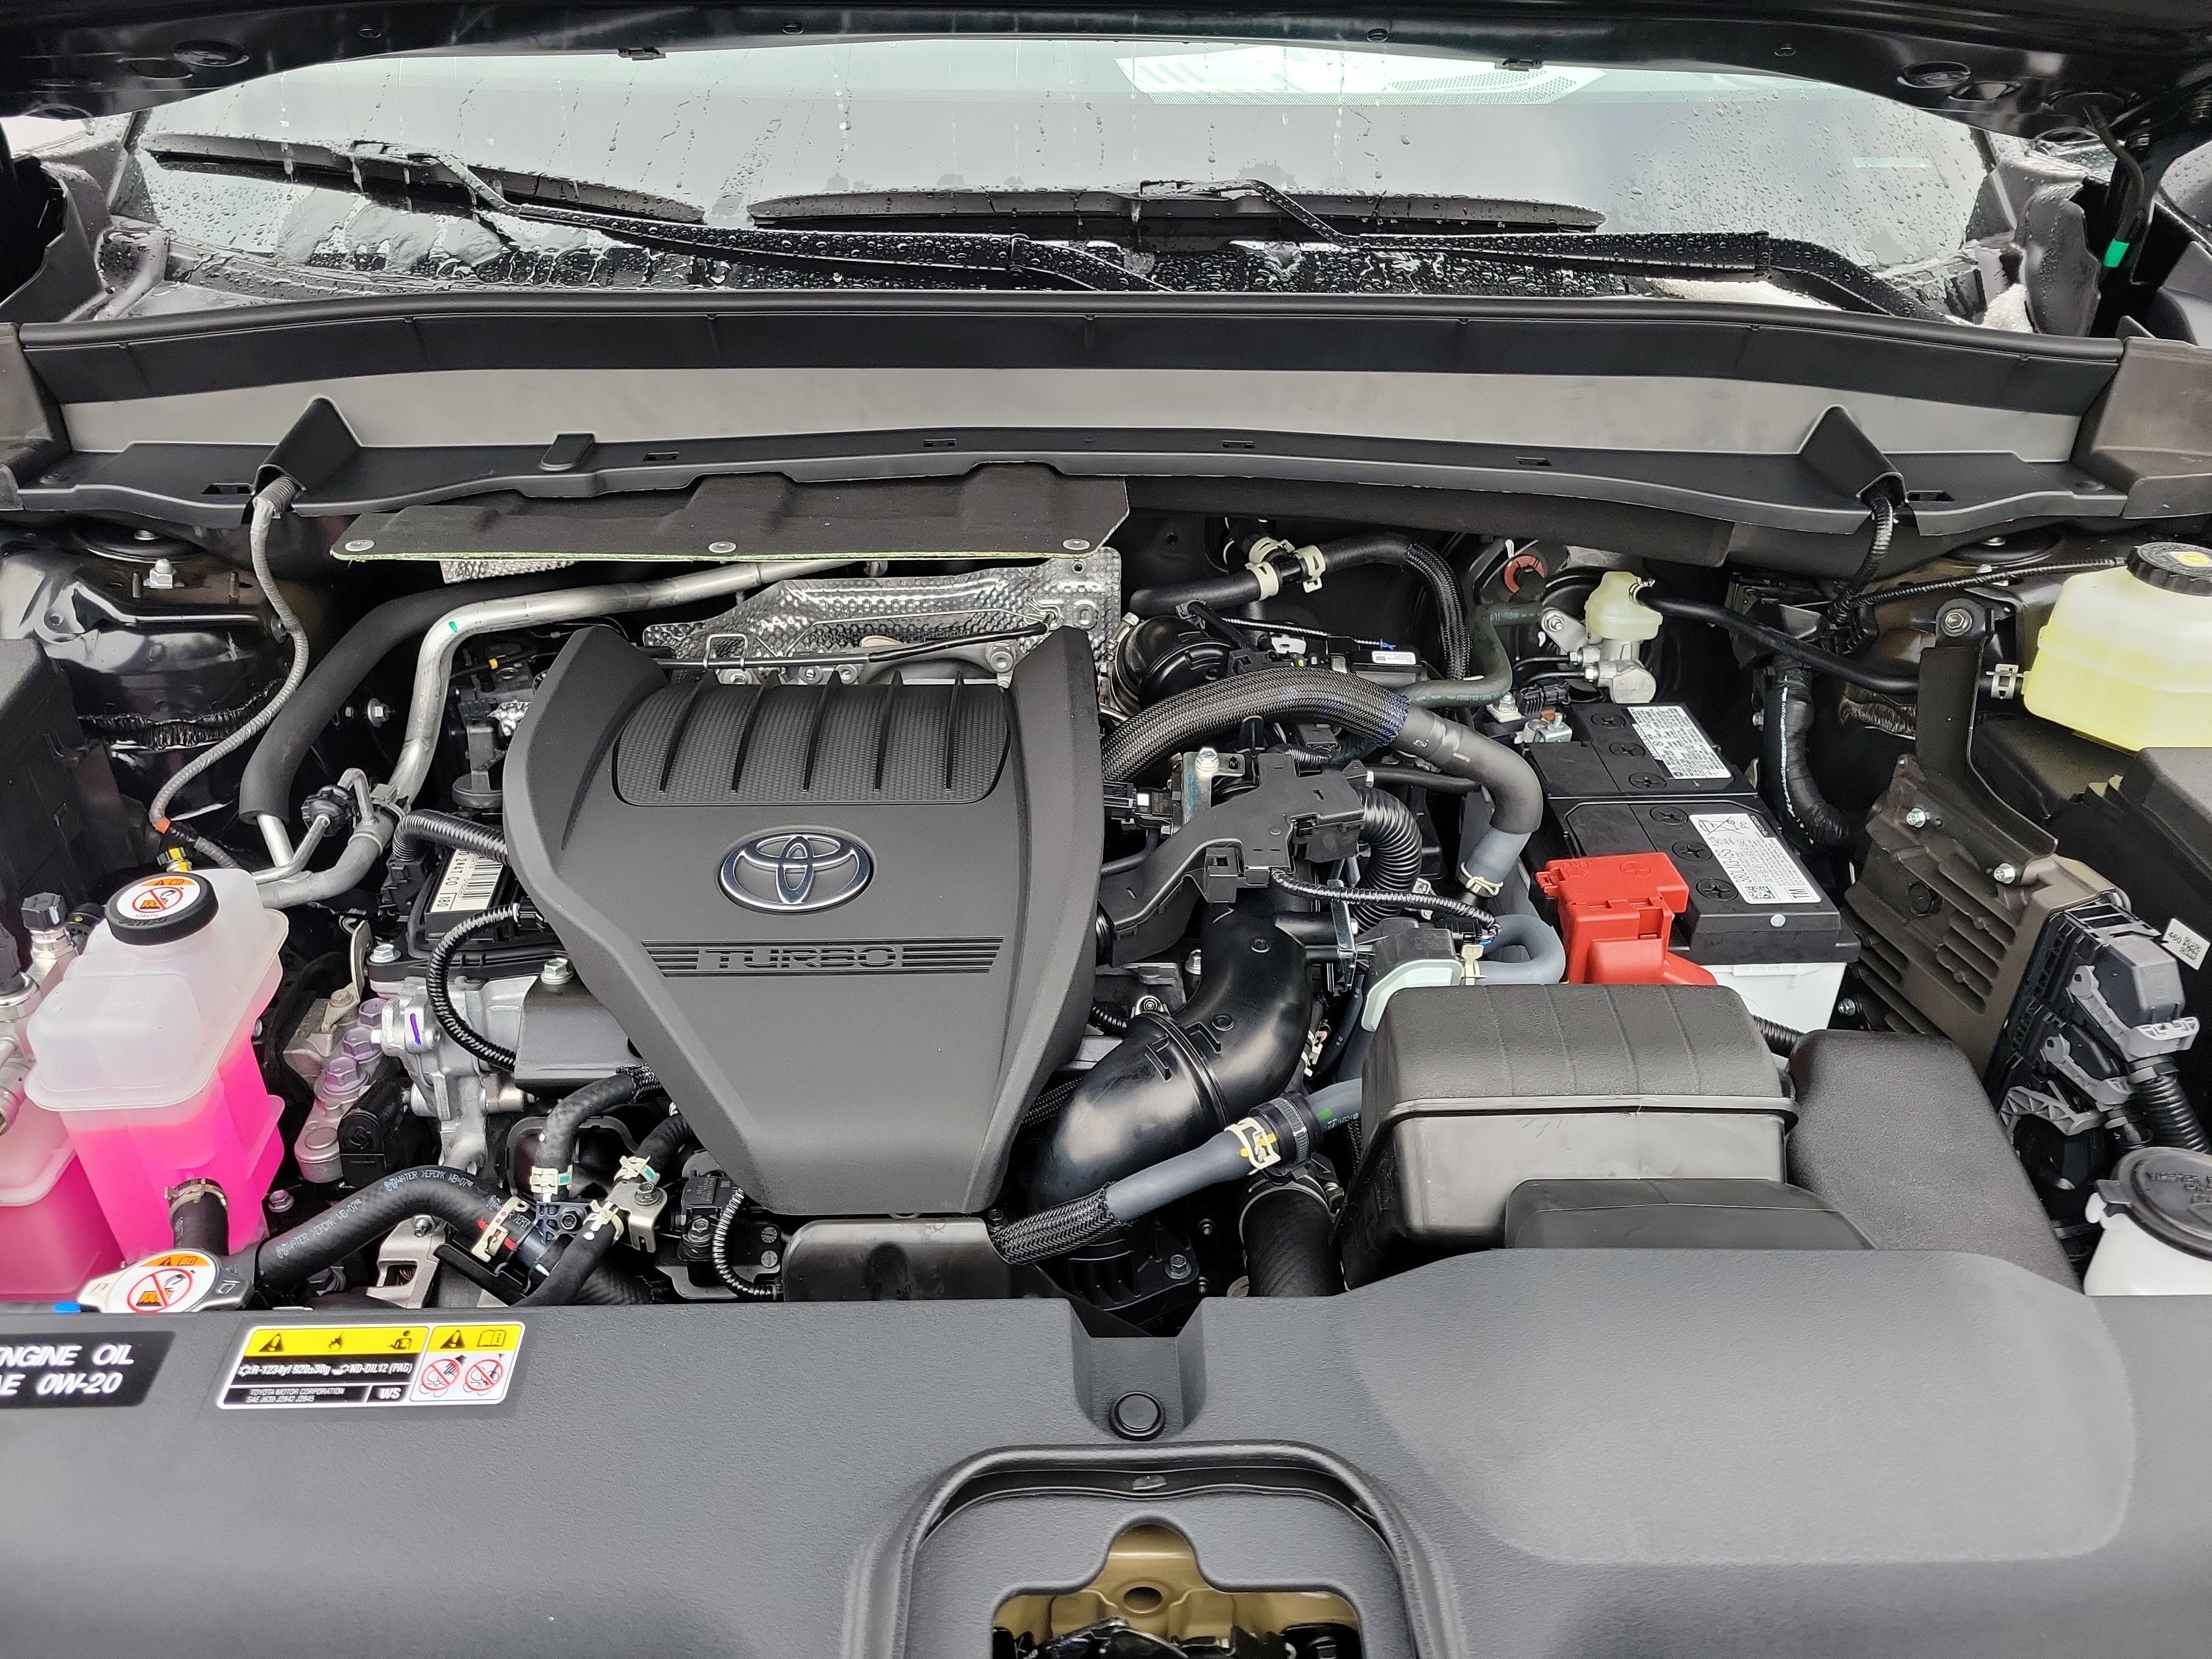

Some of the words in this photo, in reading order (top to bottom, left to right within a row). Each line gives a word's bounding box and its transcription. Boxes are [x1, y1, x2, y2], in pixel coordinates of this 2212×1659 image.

[437, 896, 452, 907] 180
[706, 945, 896, 969] TURBO
[0, 1345, 82, 1367] NGINE
[92, 1344, 134, 1365] OIL
[252, 1364, 293, 1376] R-1234yf
[388, 1362, 413, 1374] (PAG)
[0, 1374, 26, 1396] E
[36, 1372, 123, 1396] 0W-20
[380, 1388, 402, 1400] WS
